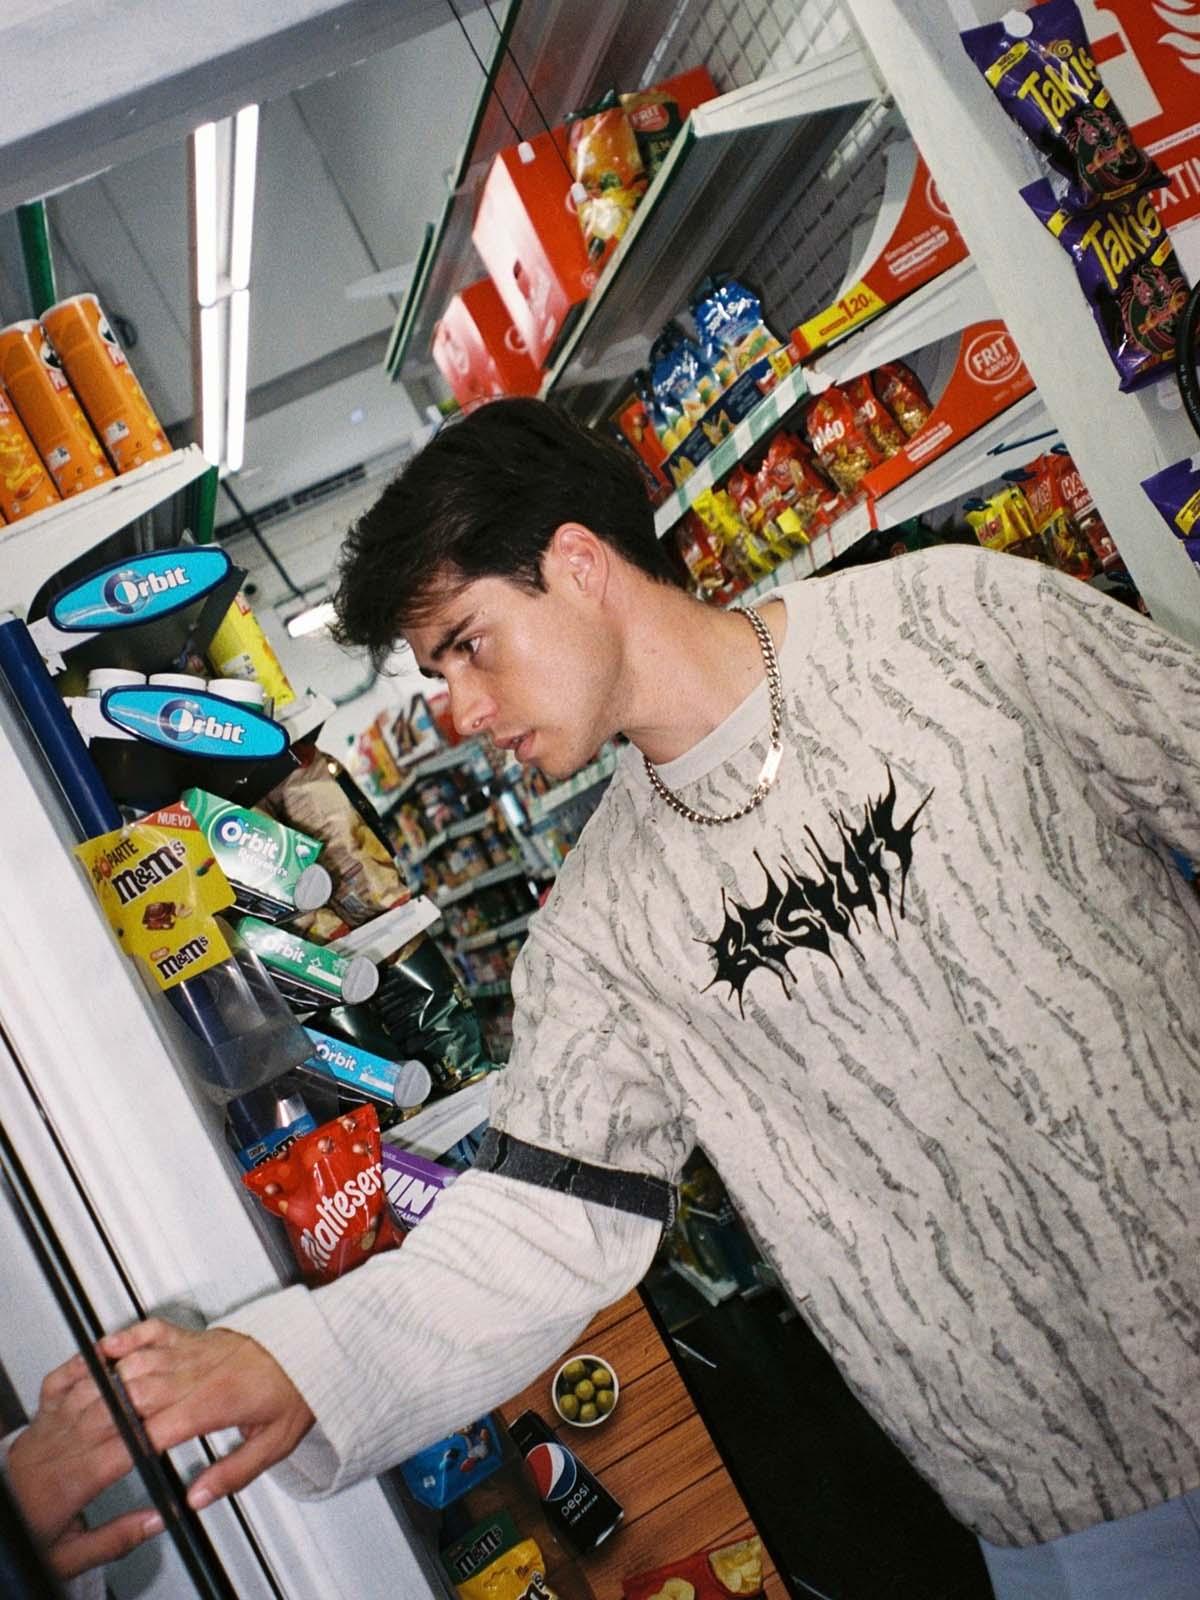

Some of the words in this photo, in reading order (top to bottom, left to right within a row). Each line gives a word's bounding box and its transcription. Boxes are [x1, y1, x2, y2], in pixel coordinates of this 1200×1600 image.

[1017, 48, 1100, 133] Takis
[1148, 157, 1200, 213] XTI
[1082, 196, 1161, 289] Takis
[972, 336, 1006, 371] FRIT
[113, 566, 190, 605] Orbit
[169, 708, 245, 744] Orbit
[157, 811, 191, 828] NUEVO
[221, 821, 278, 860] Orbit
[262, 935, 305, 964] Orbit
[316, 1043, 356, 1071] Orbit
[561, 1482, 589, 1518] pepsi
